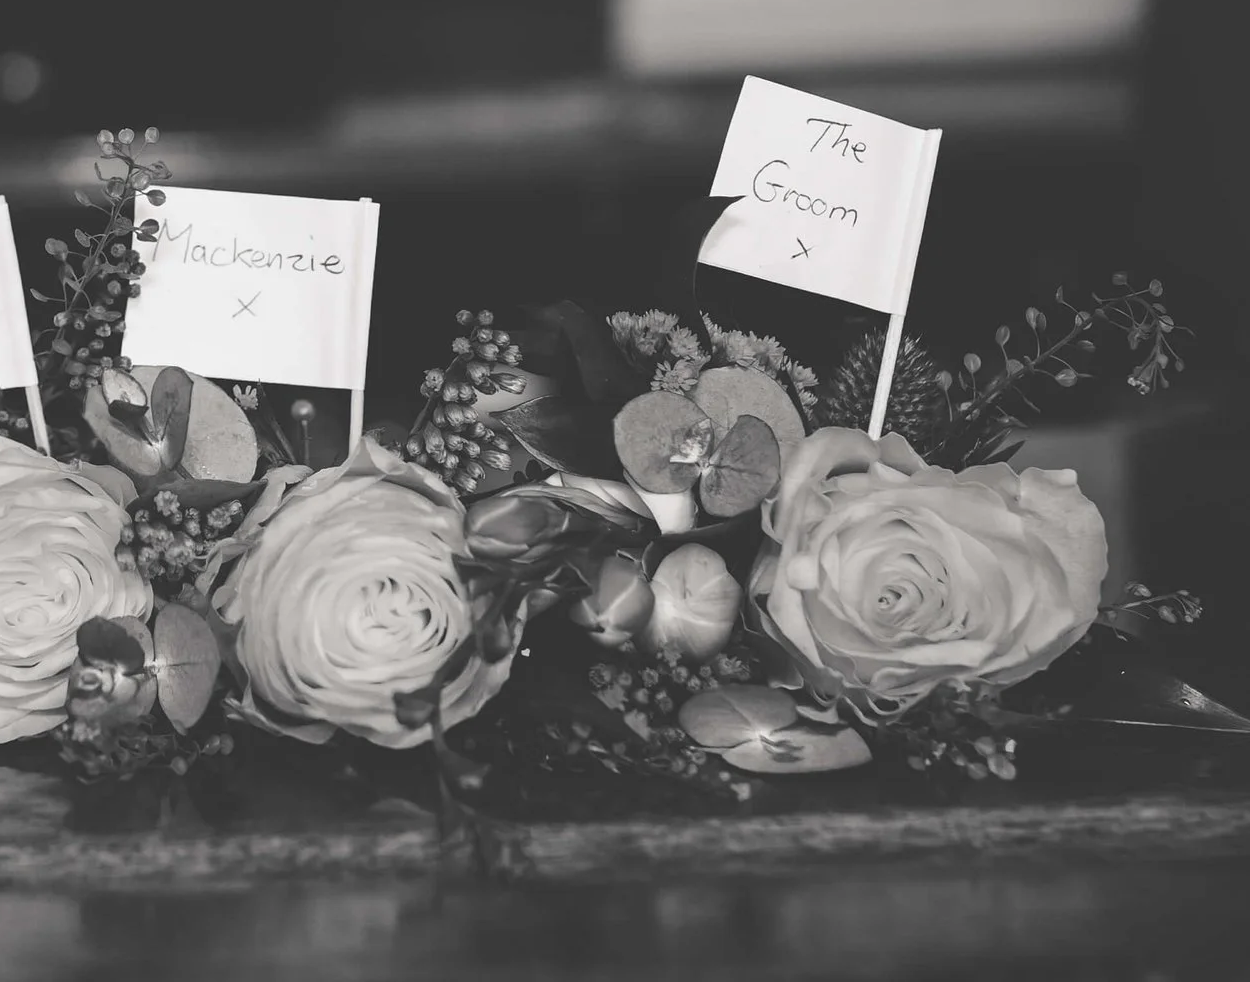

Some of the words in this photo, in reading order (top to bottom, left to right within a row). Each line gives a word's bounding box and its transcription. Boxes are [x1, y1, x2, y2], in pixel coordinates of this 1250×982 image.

[807, 118, 866, 163] The
[753, 160, 858, 227] Groom
[152, 218, 345, 274] Mackenzie
